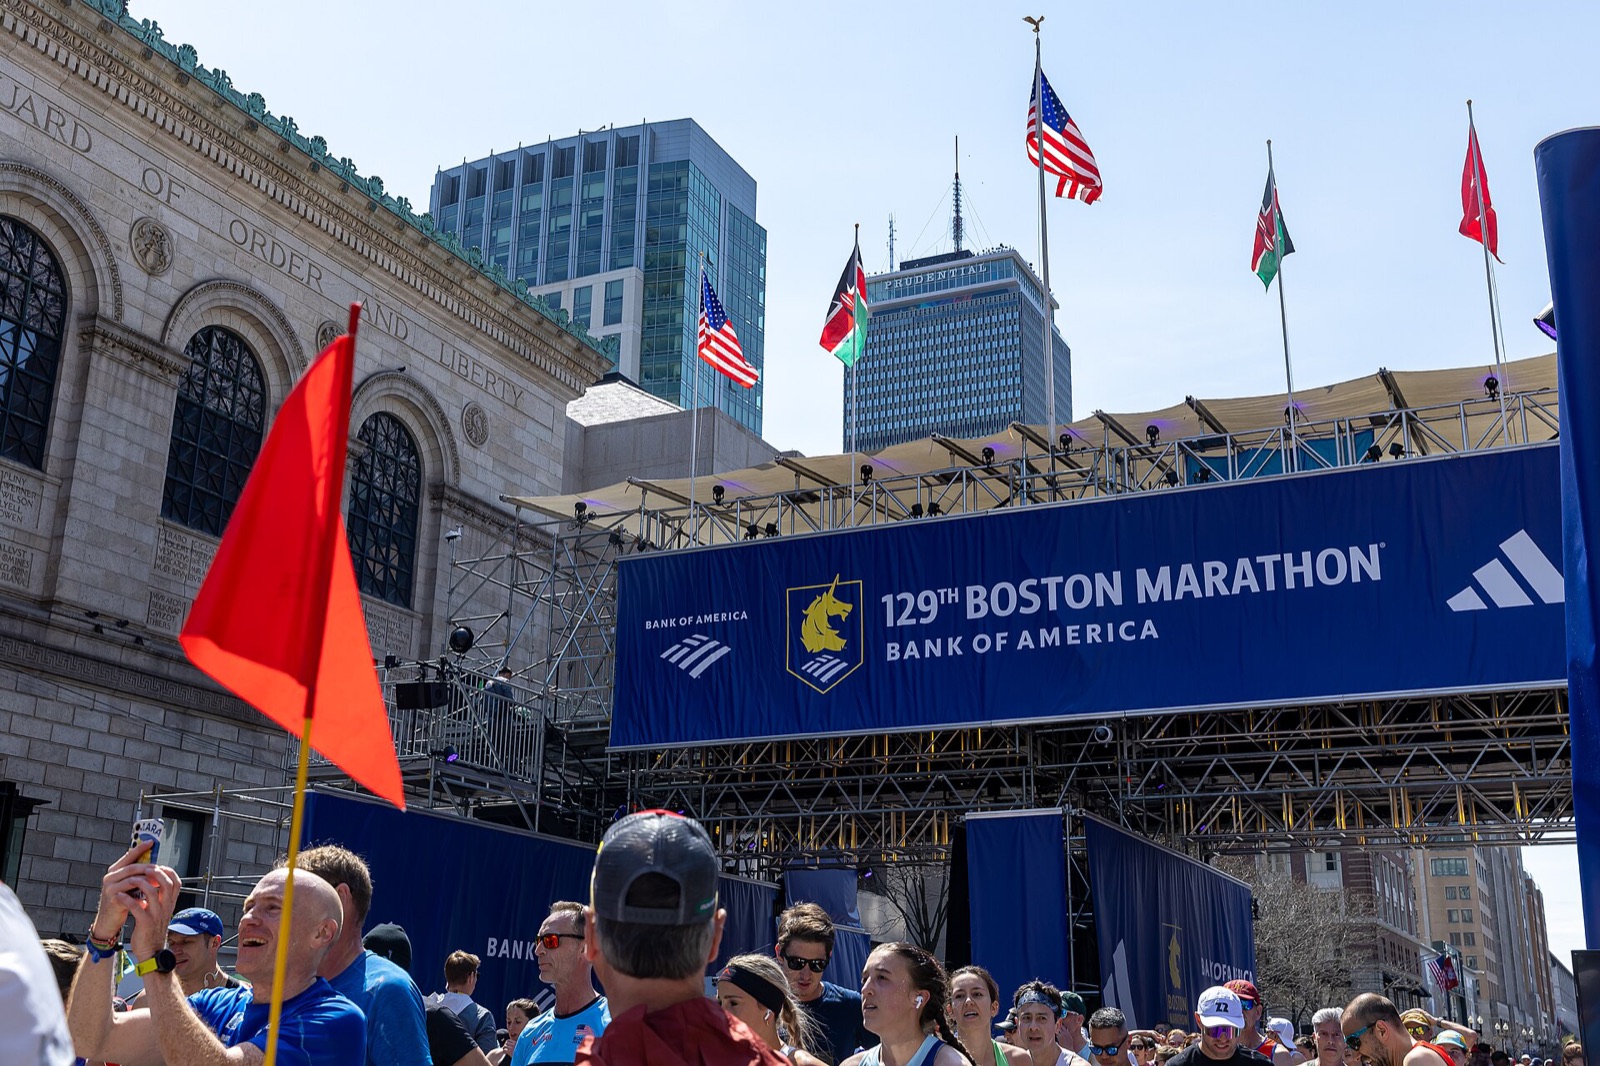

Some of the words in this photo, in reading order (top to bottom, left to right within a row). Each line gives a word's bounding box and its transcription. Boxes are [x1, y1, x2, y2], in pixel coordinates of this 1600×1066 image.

[884, 262, 988, 290] PRUDENTIAL
[141, 167, 187, 205] OF
[228, 218, 325, 294] ORDER
[360, 297, 410, 341] AND
[438, 342, 526, 408] LIBERTY
[4, 471, 27, 486] PLINY
[2, 490, 34, 508] WILSON
[3, 481, 37, 500] WERNER
[160, 528, 187, 544] STRABO
[881, 586, 959, 628] 129TH
[966, 570, 1123, 620] BOSTON
[645, 618, 677, 630] BANK
[679, 615, 694, 626] OF
[695, 610, 748, 625] AMERICA
[886, 636, 963, 661] BANK
[972, 631, 1008, 654] OF
[1016, 619, 1159, 651] AMERICA
[486, 937, 536, 961] BANK
